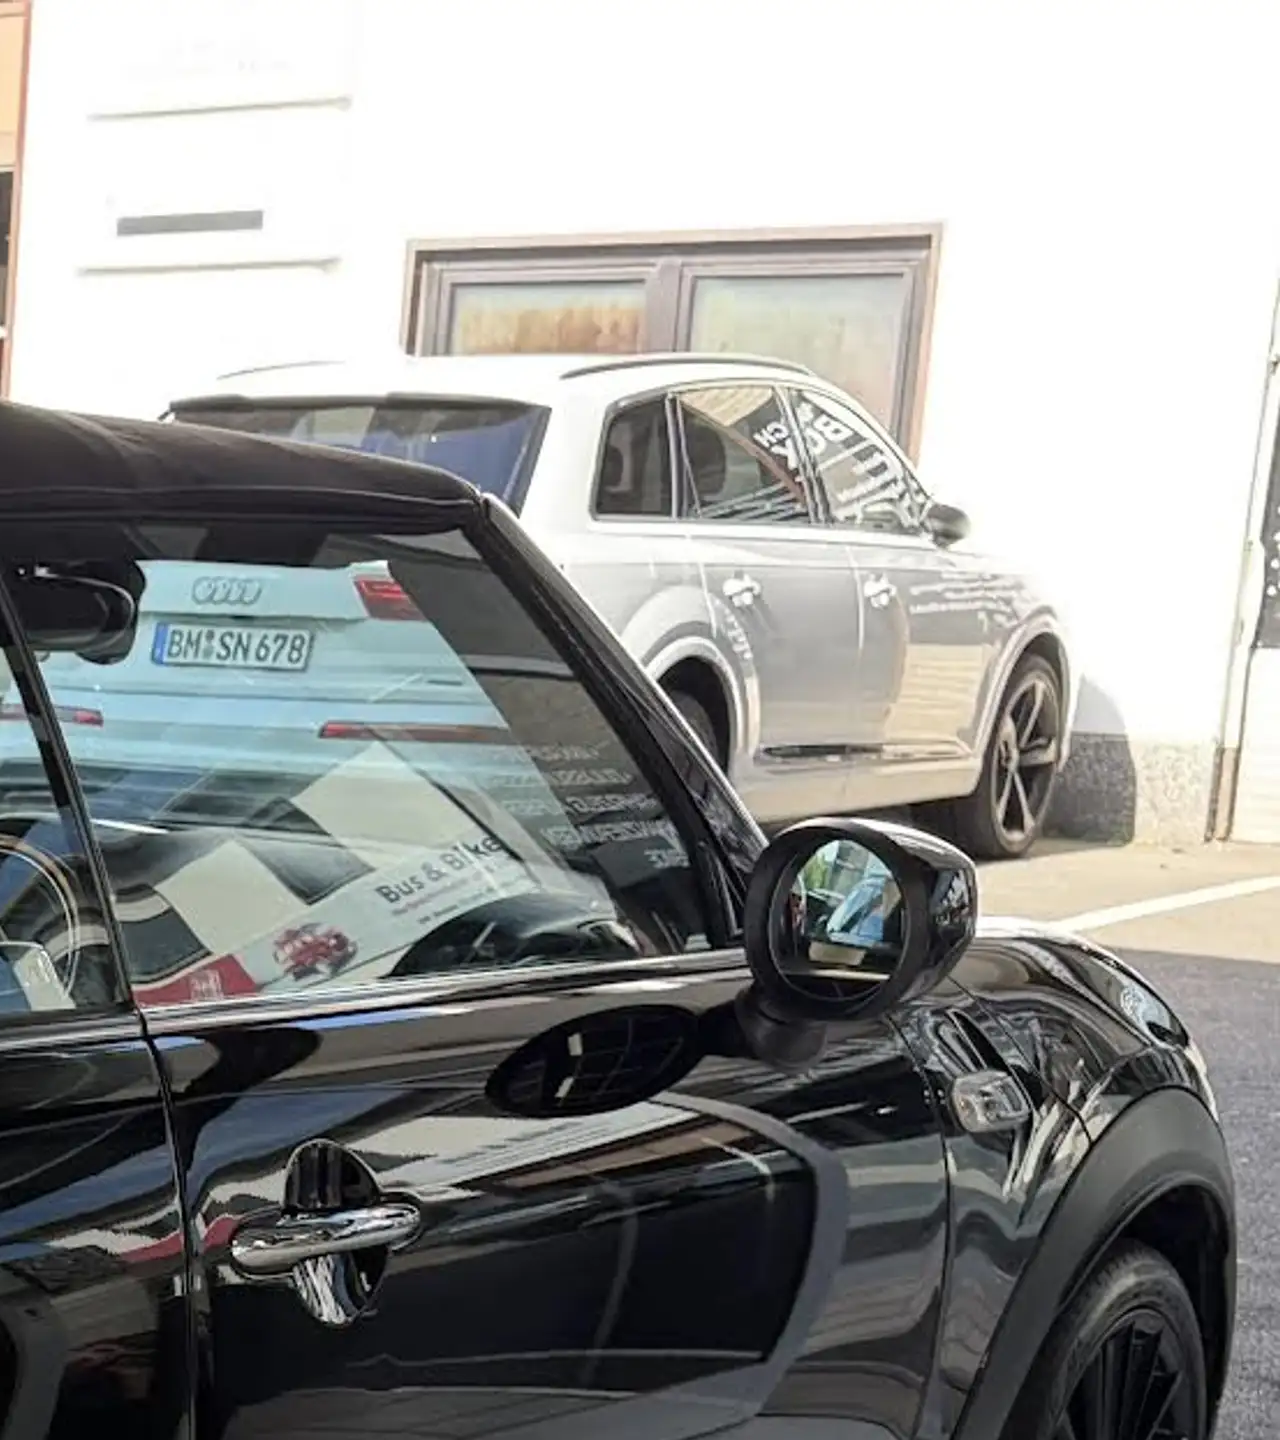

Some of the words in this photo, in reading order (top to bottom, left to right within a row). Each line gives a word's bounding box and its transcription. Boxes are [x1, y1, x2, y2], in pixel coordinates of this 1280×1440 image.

[167, 629, 202, 659] BM
[216, 631, 252, 661] SN
[255, 633, 306, 664] 678
[376, 875, 425, 904] Bus
[421, 861, 447, 882] &
